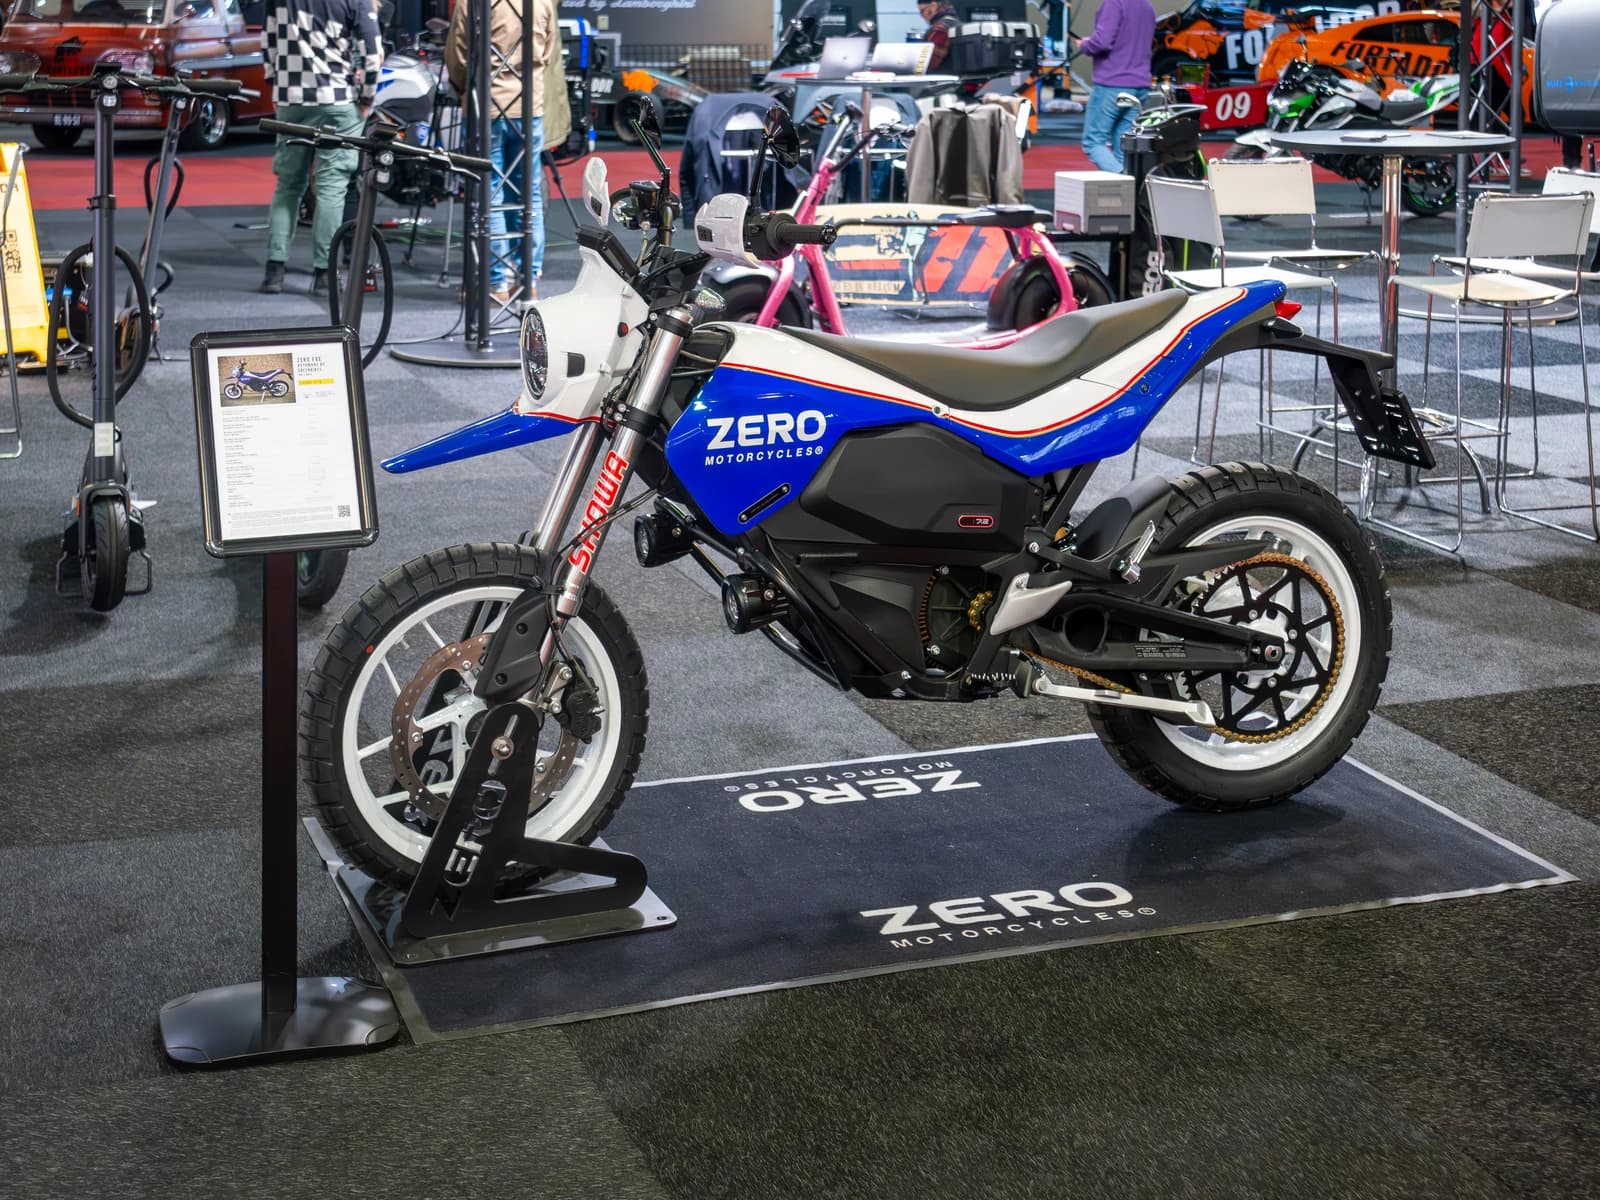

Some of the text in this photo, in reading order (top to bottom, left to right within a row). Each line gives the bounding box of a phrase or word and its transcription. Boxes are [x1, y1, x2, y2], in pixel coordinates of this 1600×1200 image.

[1215, 91, 1251, 121] 09
[707, 409, 827, 450] ZERO
[568, 449, 630, 575] SHOWA
[738, 769, 982, 812] ZERO
[430, 779, 508, 921] ZERO
[859, 881, 1134, 935] ZERO
